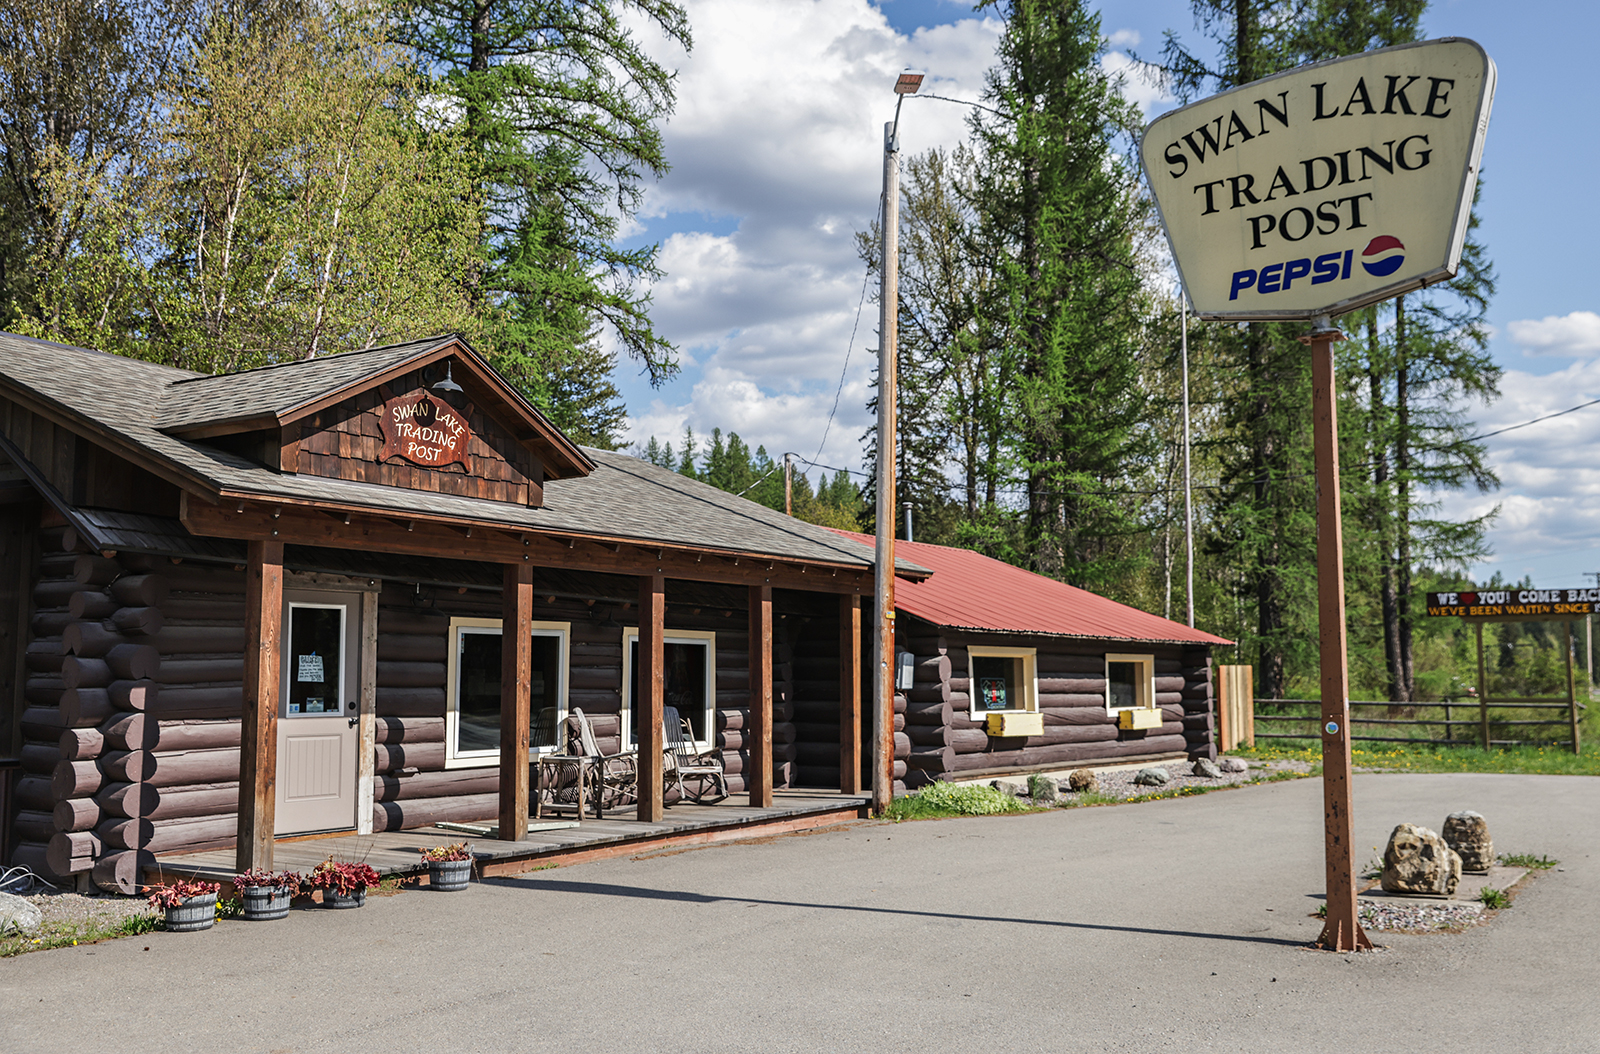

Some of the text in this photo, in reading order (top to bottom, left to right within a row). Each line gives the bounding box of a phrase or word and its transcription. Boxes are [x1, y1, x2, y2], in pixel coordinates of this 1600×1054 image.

[1164, 75, 1456, 179] SWAN LAKE
[1193, 134, 1433, 216] TRADING
[1246, 193, 1373, 251] POST
[1228, 249, 1354, 301] PEPSI
[392, 402, 466, 438] SWAN LAKE
[395, 423, 457, 451] TRADING
[407, 441, 443, 462] POST
[1436, 592, 1458, 605] WE
[1477, 590, 1511, 605] YOU!
[1518, 590, 1561, 604] COME
[1469, 605, 1502, 616] BEEN
[1554, 603, 1590, 614] SINCE
